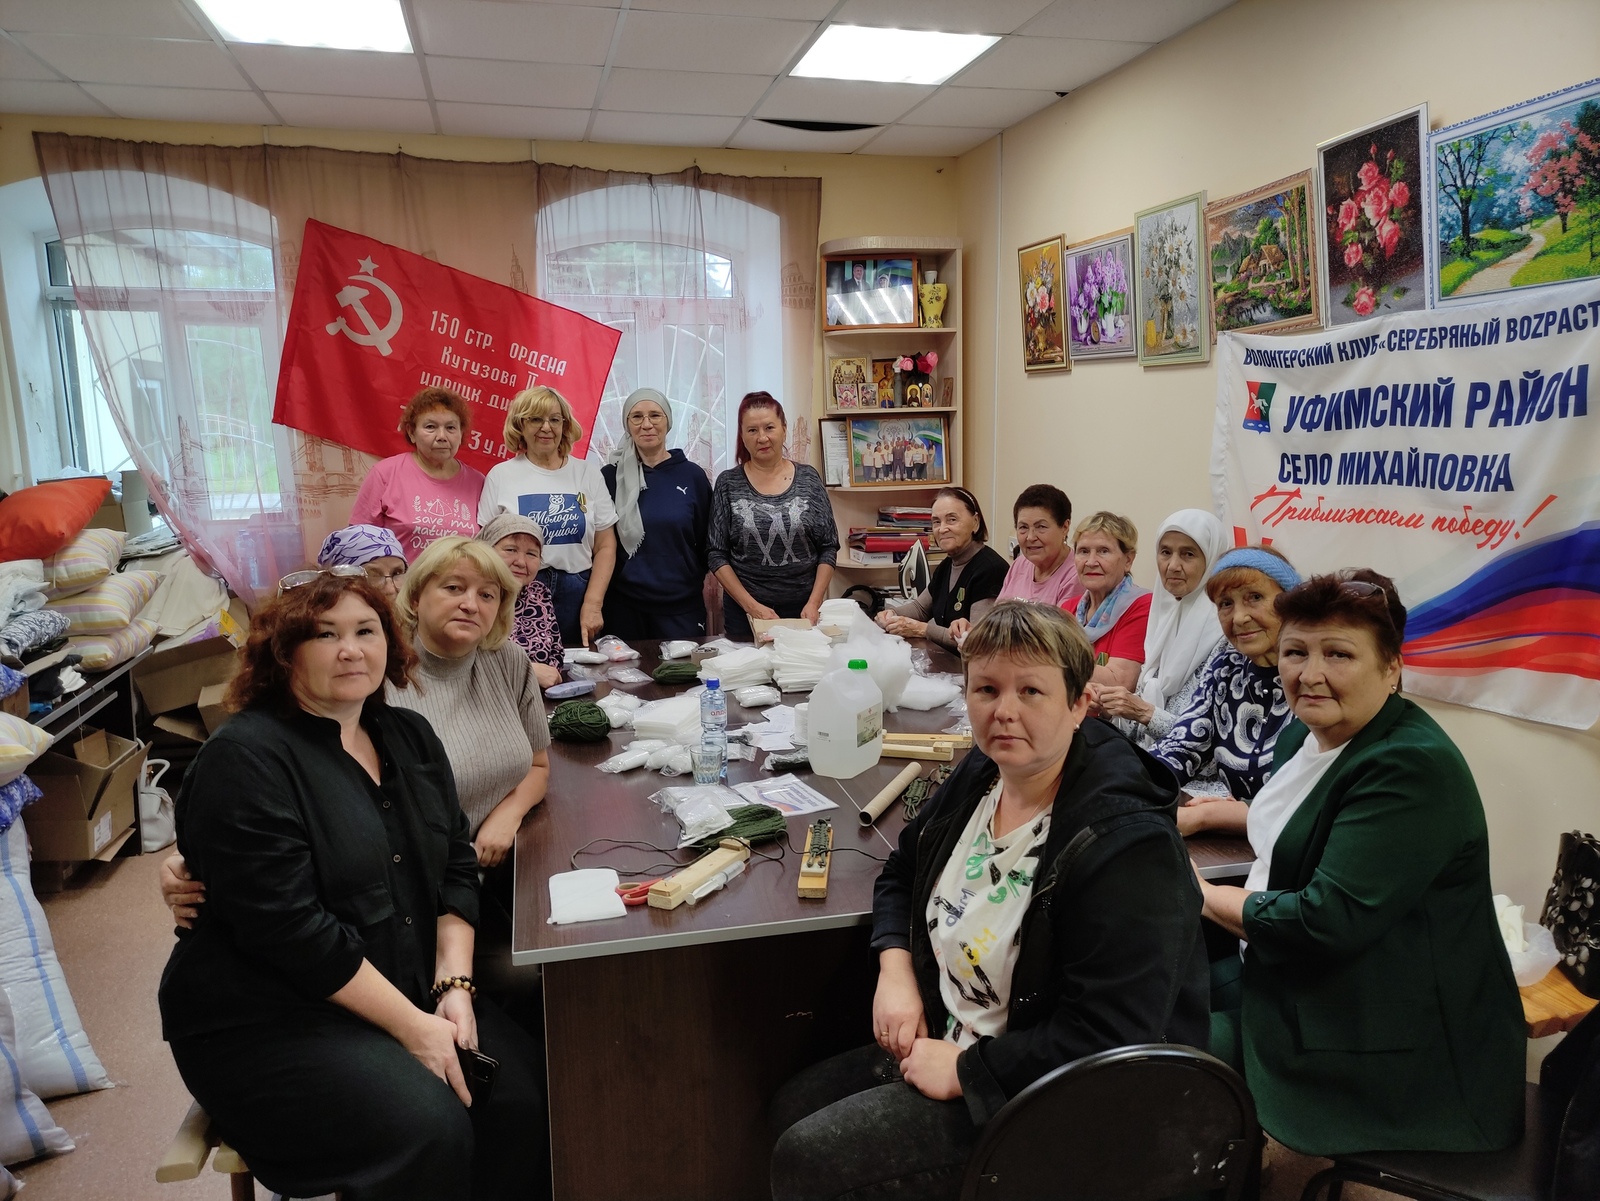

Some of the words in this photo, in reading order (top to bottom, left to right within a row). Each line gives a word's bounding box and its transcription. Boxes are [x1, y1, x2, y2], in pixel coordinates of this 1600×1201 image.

[430, 310, 460, 339] 150
[509, 342, 567, 376] ОРДЕНА
[1243, 342, 1334, 369] ВОЛОНТЕРСКИЙ
[1283, 376, 1455, 433] УФИМСКИЙ
[1464, 364, 1589, 428] РАЙОН
[1278, 452, 1333, 486] СЕЛО
[1337, 447, 1514, 492] МИХАЙЛОВКА
[412, 515, 444, 526] save
[451, 518, 475, 538] my
[412, 523, 459, 537] nature
[528, 510, 579, 529] Молоды
[1250, 484, 1425, 528] Приближаем
[1431, 494, 1558, 550] победу!
